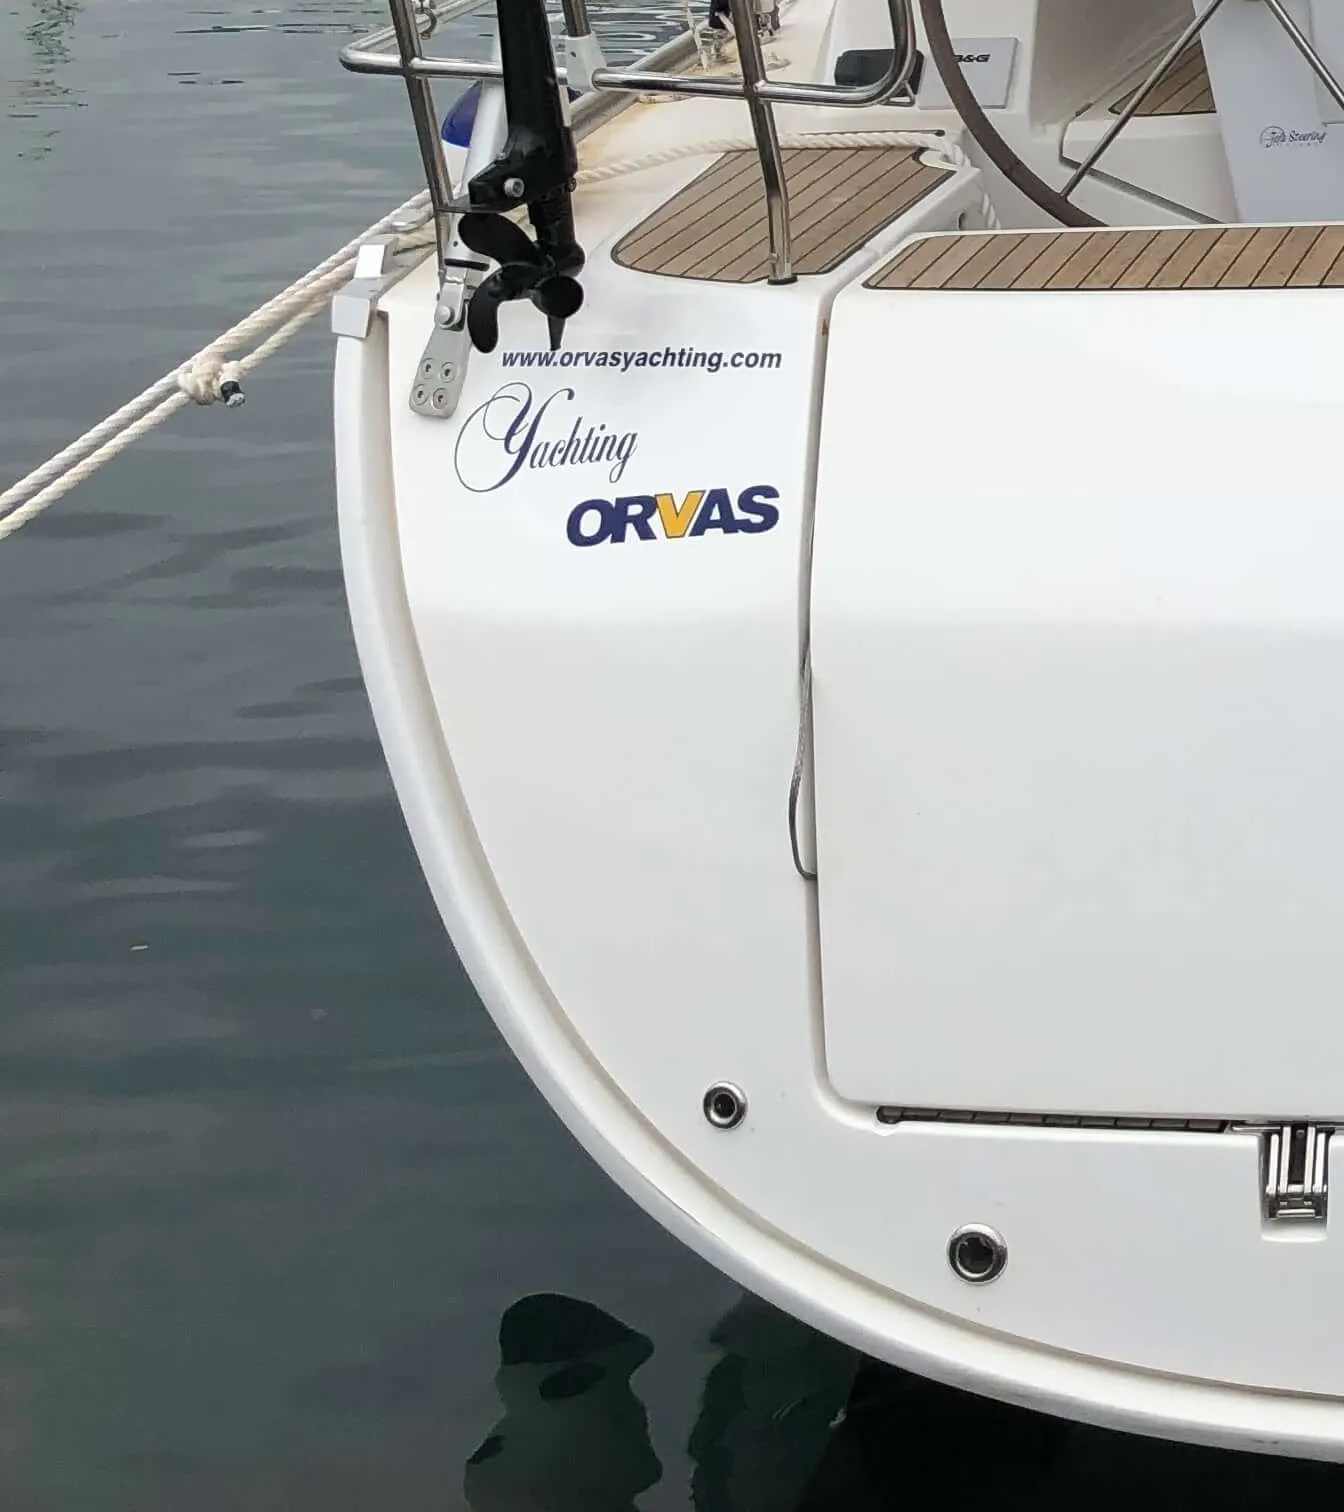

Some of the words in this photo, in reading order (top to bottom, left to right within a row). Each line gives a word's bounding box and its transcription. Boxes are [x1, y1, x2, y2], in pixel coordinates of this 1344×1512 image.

[501, 347, 783, 373] www.orvasyachting.com
[453, 381, 638, 493] Yachting
[566, 484, 780, 548] ORVAS
